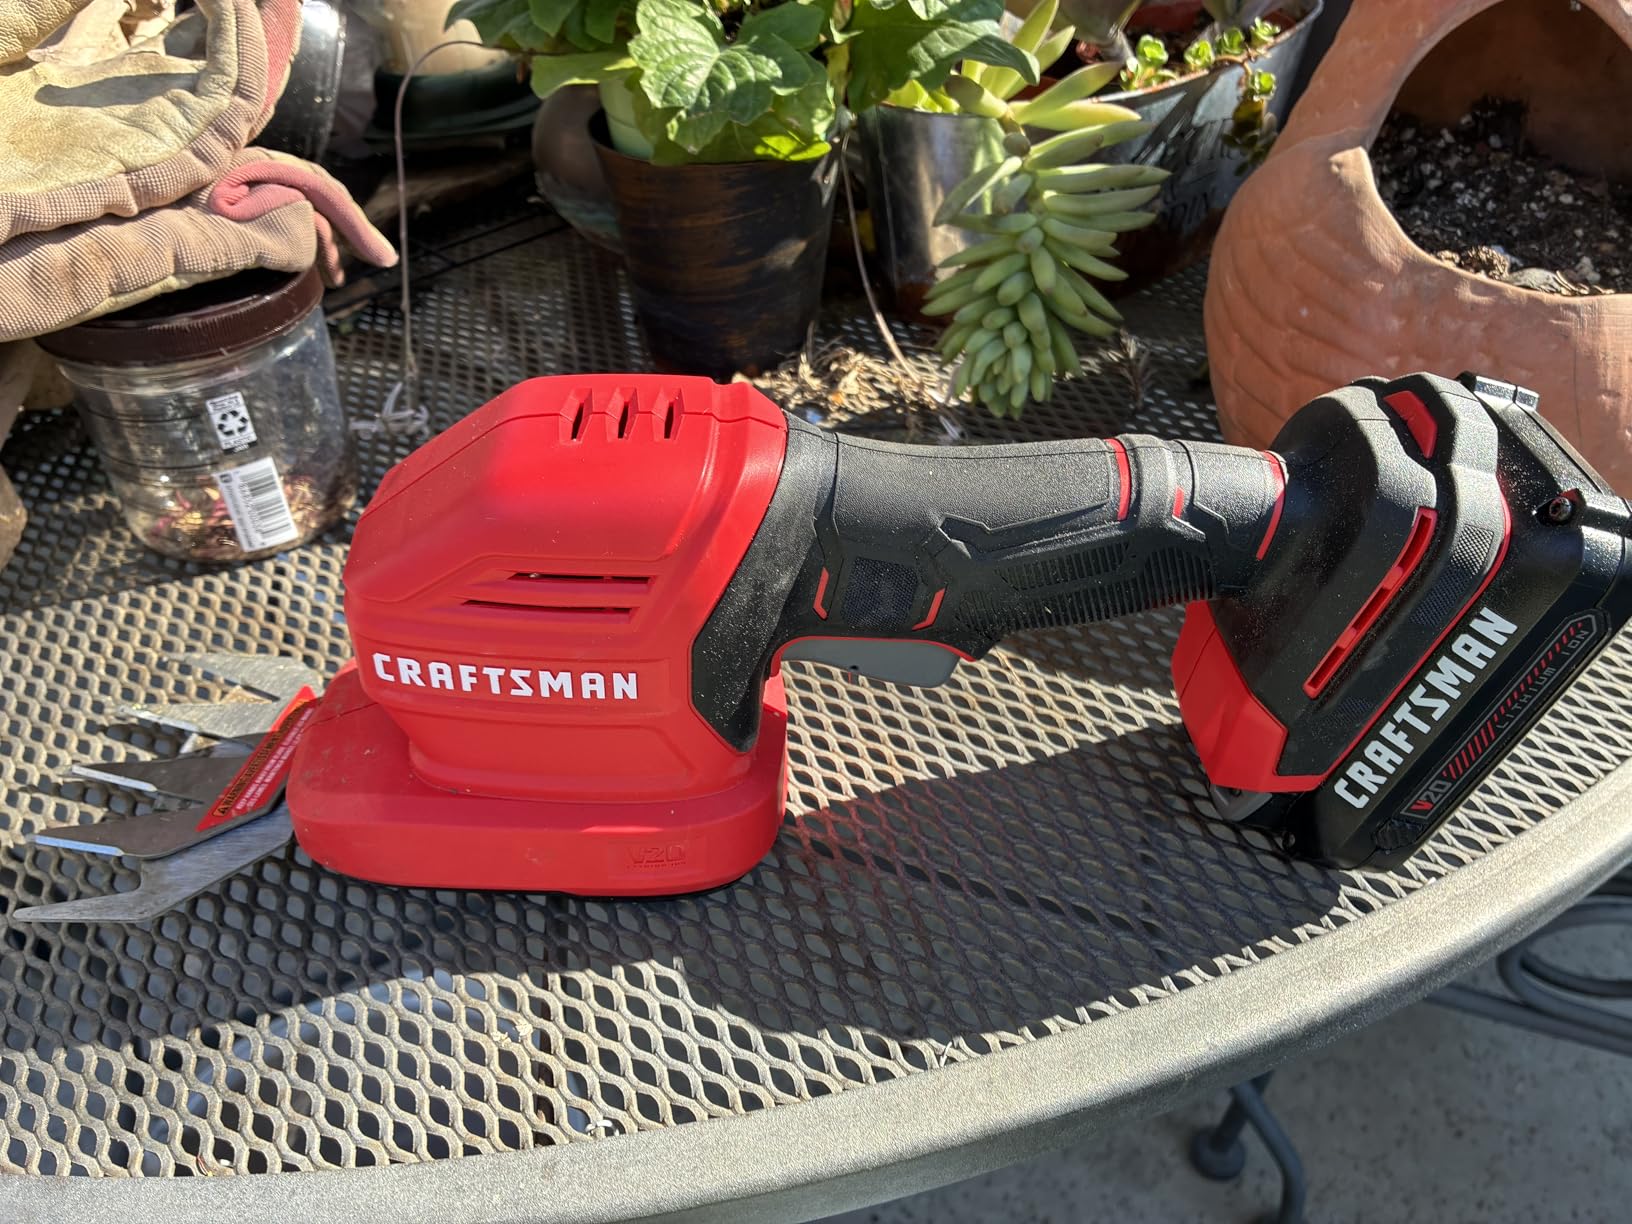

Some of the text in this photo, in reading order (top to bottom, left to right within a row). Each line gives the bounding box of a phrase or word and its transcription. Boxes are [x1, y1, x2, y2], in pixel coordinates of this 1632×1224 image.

[372, 652, 638, 700] CRAFTSMAN
[1334, 606, 1518, 808] CRAFTSMAN
[1410, 629, 1589, 812] V20 LITHIUM ION
[629, 842, 686, 864] V20
